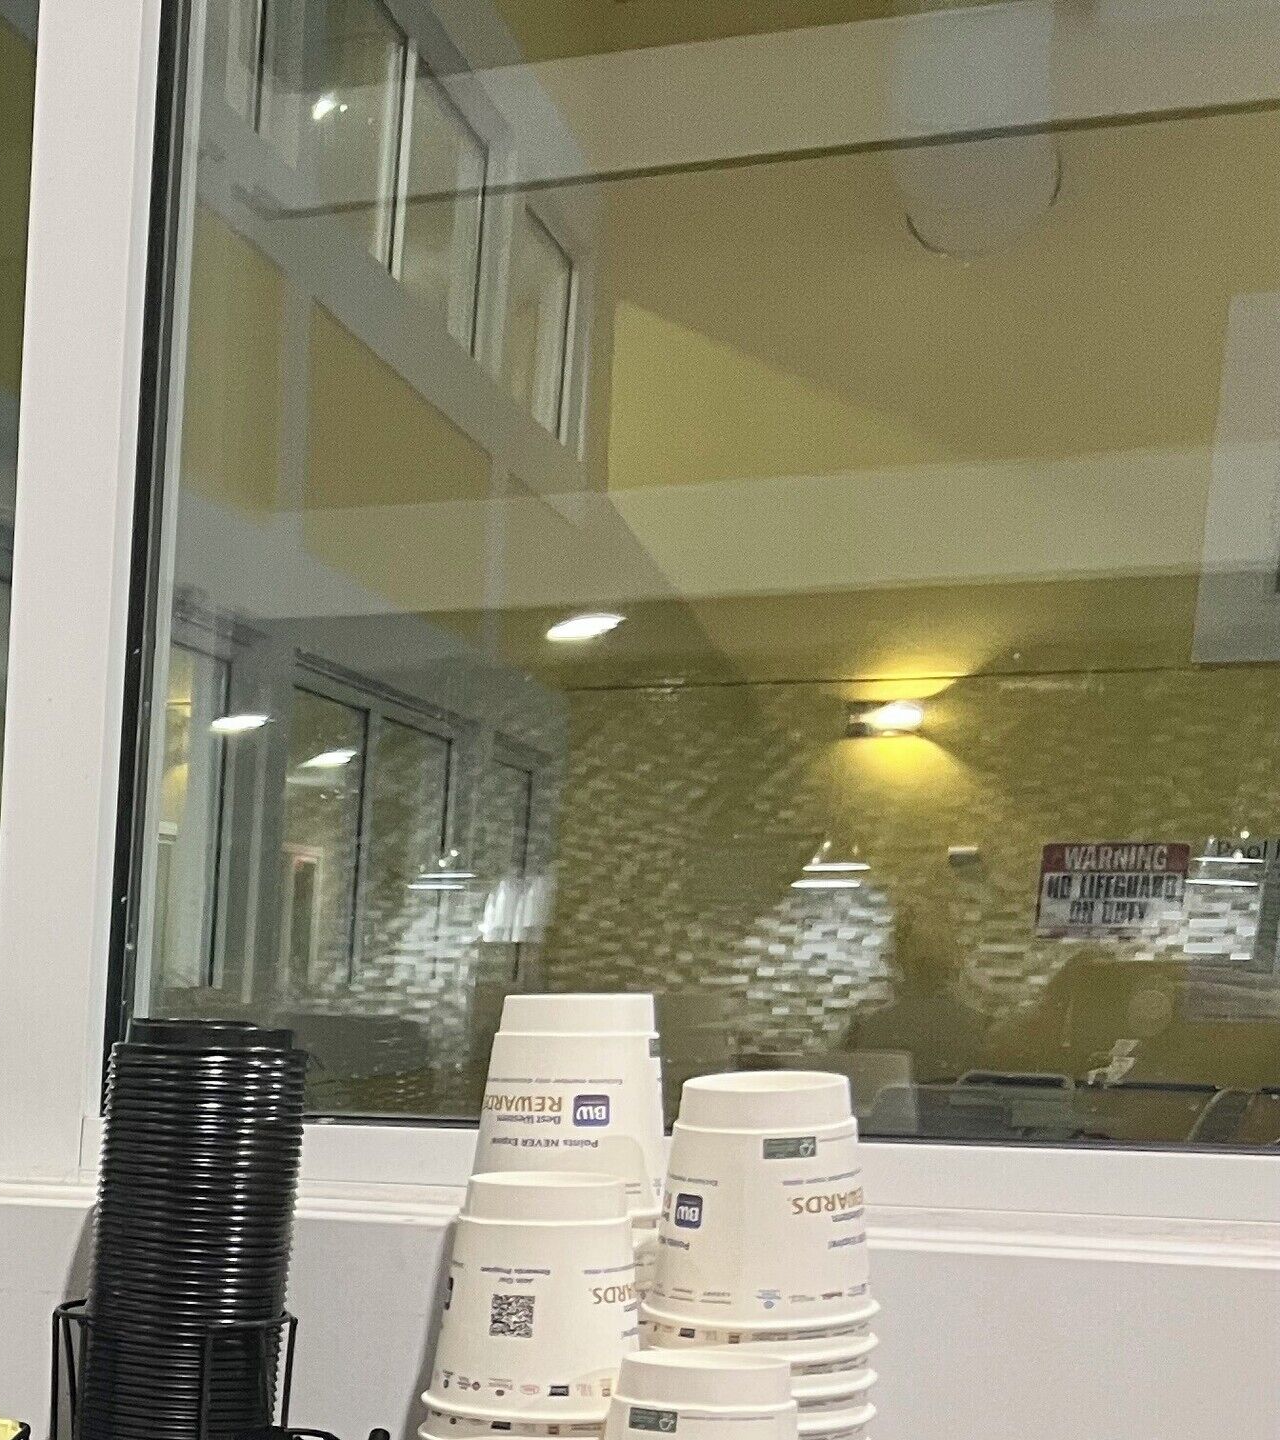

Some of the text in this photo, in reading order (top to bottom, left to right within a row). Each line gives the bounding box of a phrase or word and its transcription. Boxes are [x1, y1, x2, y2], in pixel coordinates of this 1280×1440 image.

[1064, 846, 1168, 870] WARNING
[1046, 874, 1072, 899] NO
[483, 1096, 563, 1113] REWARD
[576, 1105, 607, 1121] BW
[521, 1138, 560, 1148] NEVER
